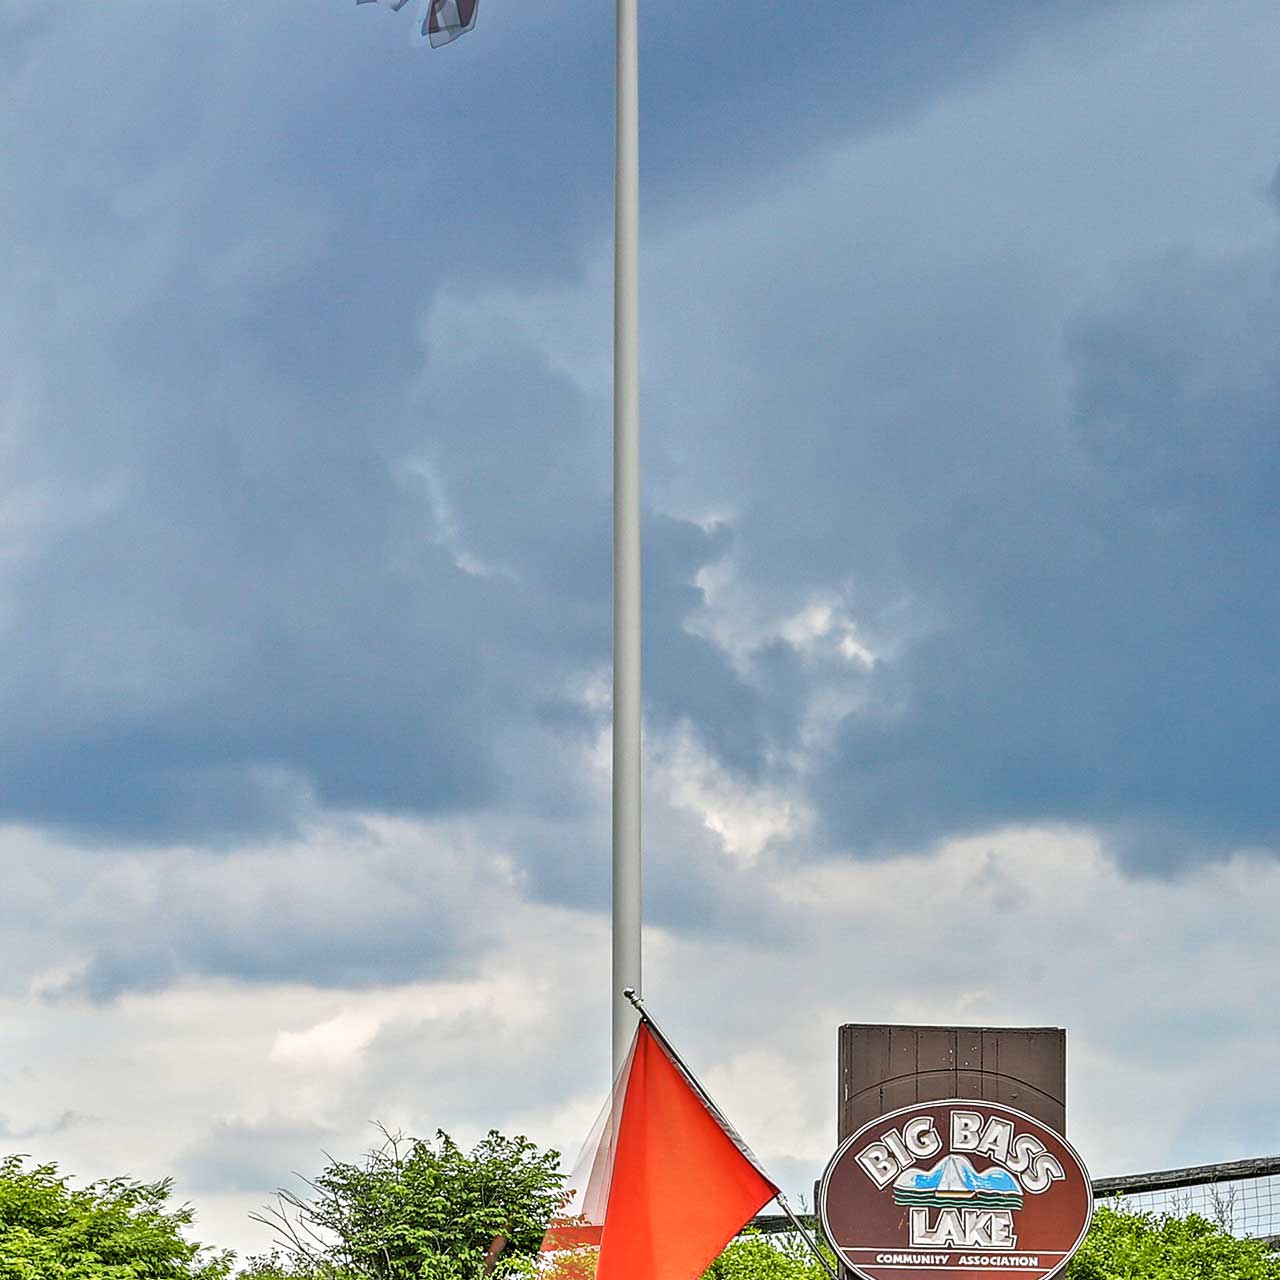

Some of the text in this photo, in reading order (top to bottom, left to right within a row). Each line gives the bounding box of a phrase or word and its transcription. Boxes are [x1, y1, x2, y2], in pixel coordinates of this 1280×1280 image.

[855, 1110, 1066, 1194] BIG BASS
[909, 1207, 1017, 1249] LAKE
[876, 1254, 1039, 1266] COMMUNITY ASSOCIATION
